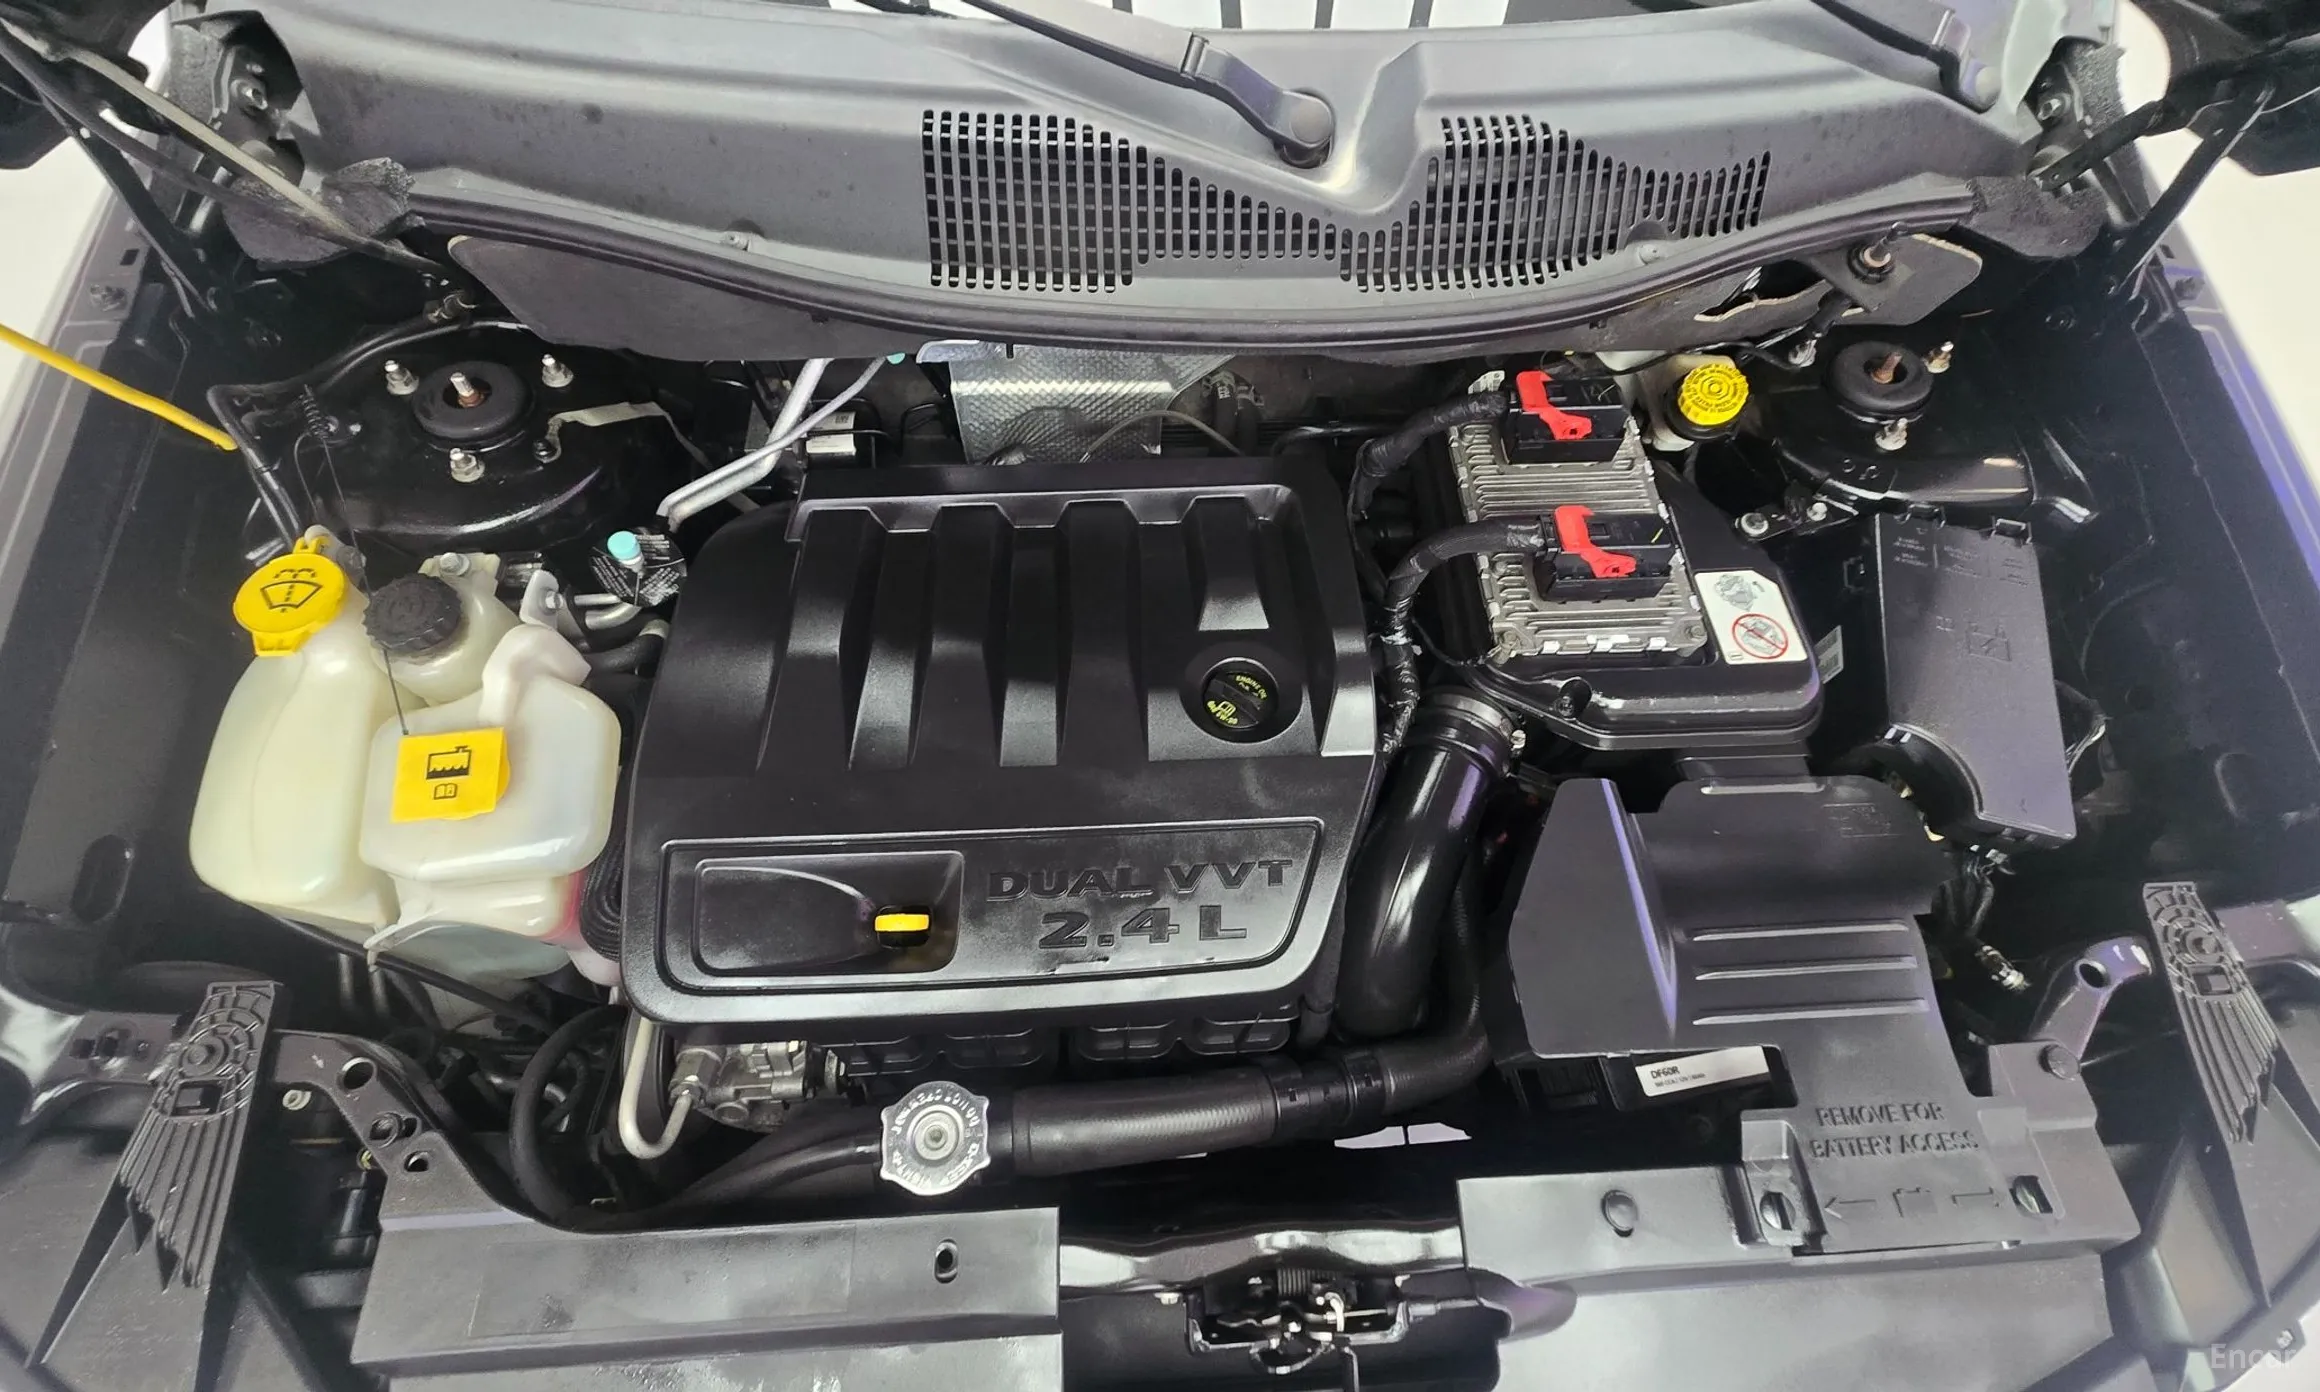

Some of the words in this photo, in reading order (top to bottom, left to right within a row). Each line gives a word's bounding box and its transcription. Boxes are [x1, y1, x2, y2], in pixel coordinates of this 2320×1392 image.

[987, 866, 1155, 902] DUAL
[1164, 859, 1293, 894] VVT
[1815, 1103, 1899, 1127] REMOVE
[1902, 1101, 1945, 1122] FOR
[1809, 1135, 1892, 1158] BATTERY
[1899, 1130, 1979, 1154] ACCESS
